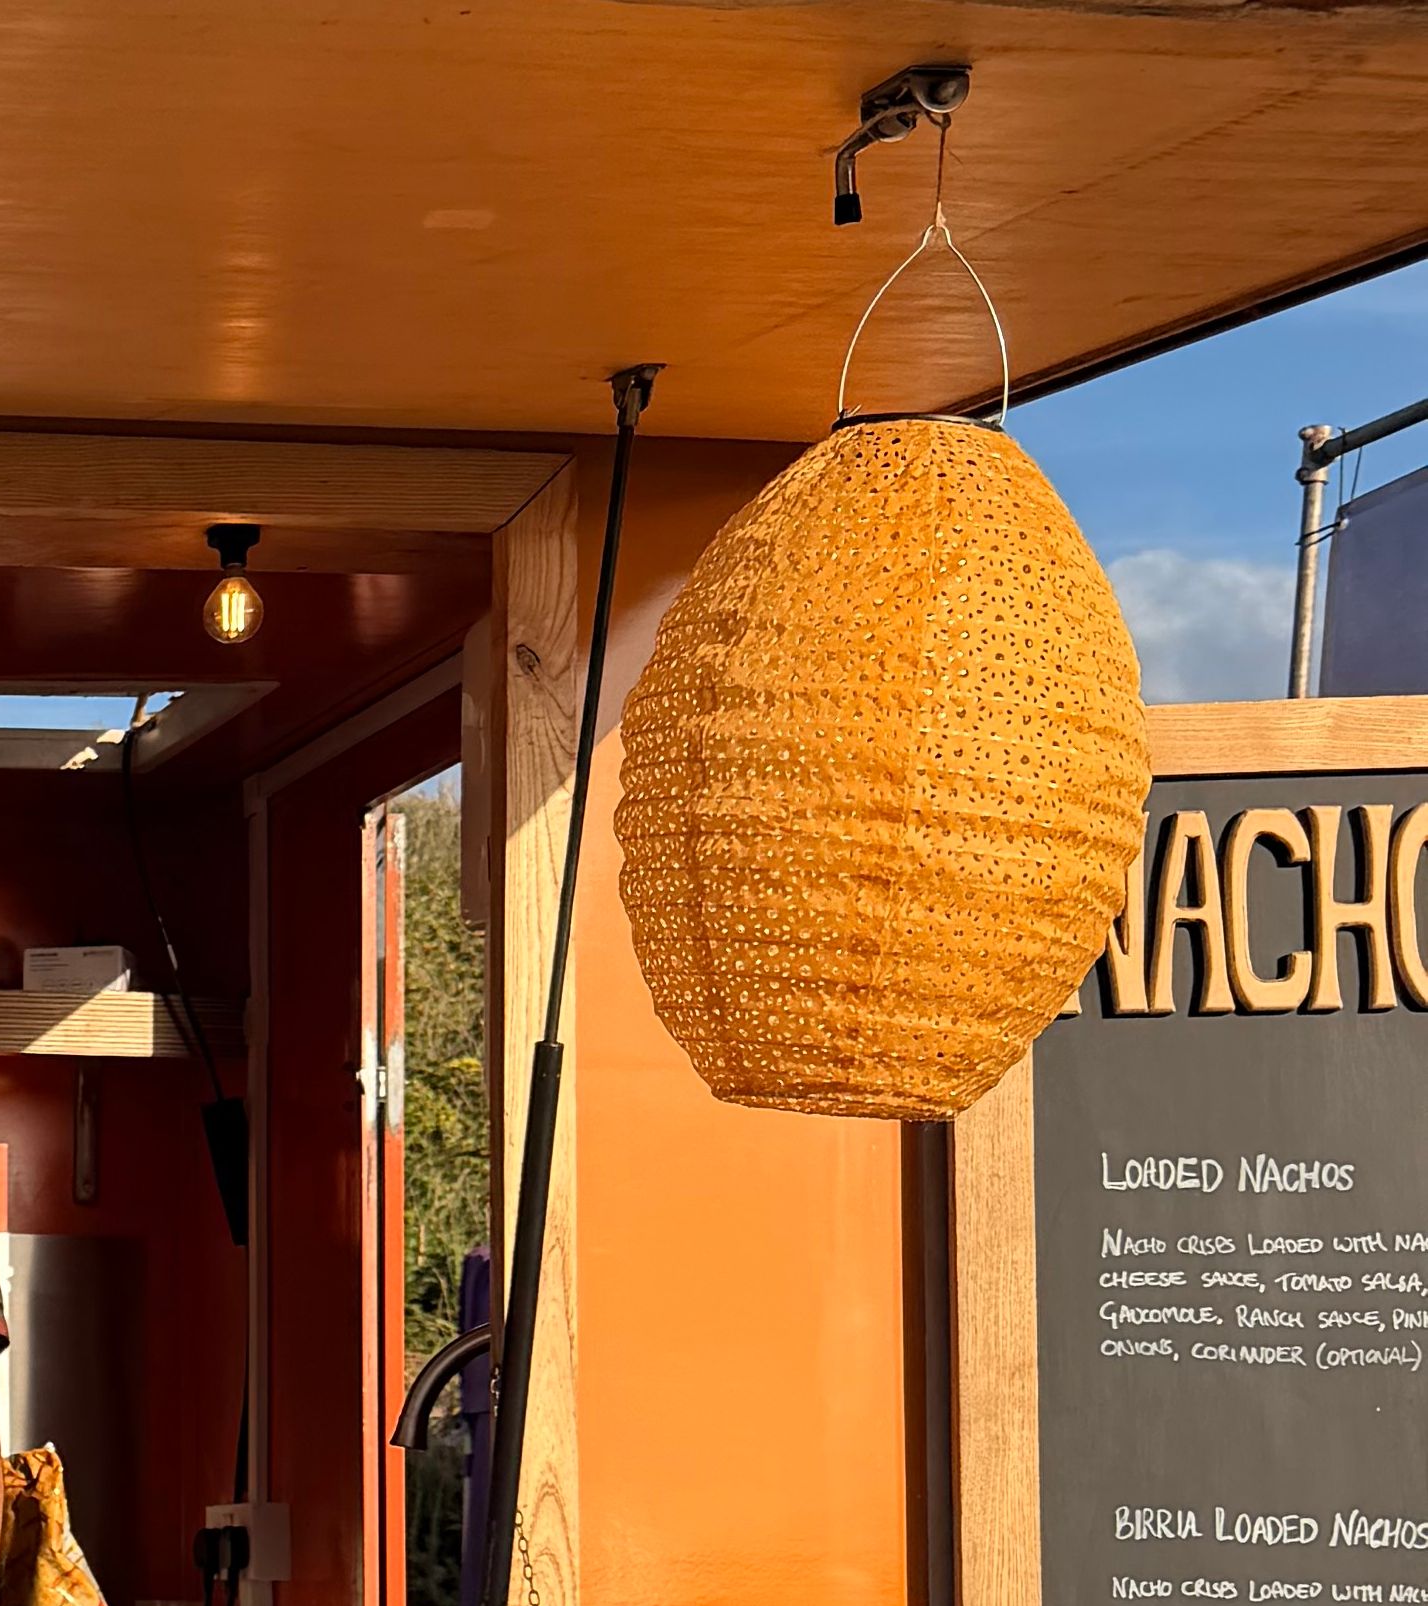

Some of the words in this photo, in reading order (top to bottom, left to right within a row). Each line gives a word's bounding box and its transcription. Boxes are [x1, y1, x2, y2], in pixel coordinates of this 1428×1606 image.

[1101, 1152, 1224, 1194] LOADED
[1238, 1153, 1355, 1193] NACHOS
[1101, 1228, 1167, 1258] NACHO
[1176, 1234, 1236, 1256] CRISPS
[1248, 1233, 1324, 1256] LOADED
[1333, 1231, 1388, 1254] WITH
[1099, 1271, 1187, 1289] CHEESE
[1201, 1270, 1266, 1293] SAUCE,
[1274, 1271, 1352, 1293] TOMATO
[1236, 1304, 1304, 1328] RANCH
[1317, 1309, 1386, 1332] SAUCE,
[1100, 1338, 1180, 1361] ONIONS,
[1191, 1342, 1307, 1367] CORIANDER
[1315, 1340, 1422, 1372] (OPTIONAL)
[1114, 1505, 1203, 1540] BIRRIA
[1215, 1507, 1319, 1546] LOADED
[1328, 1509, 1428, 1550] NACHOS
[1112, 1576, 1173, 1600] NACHO
[1181, 1578, 1238, 1600] CRISPS
[1249, 1580, 1323, 1602] LOADED
[1331, 1584, 1383, 1603] WITH
